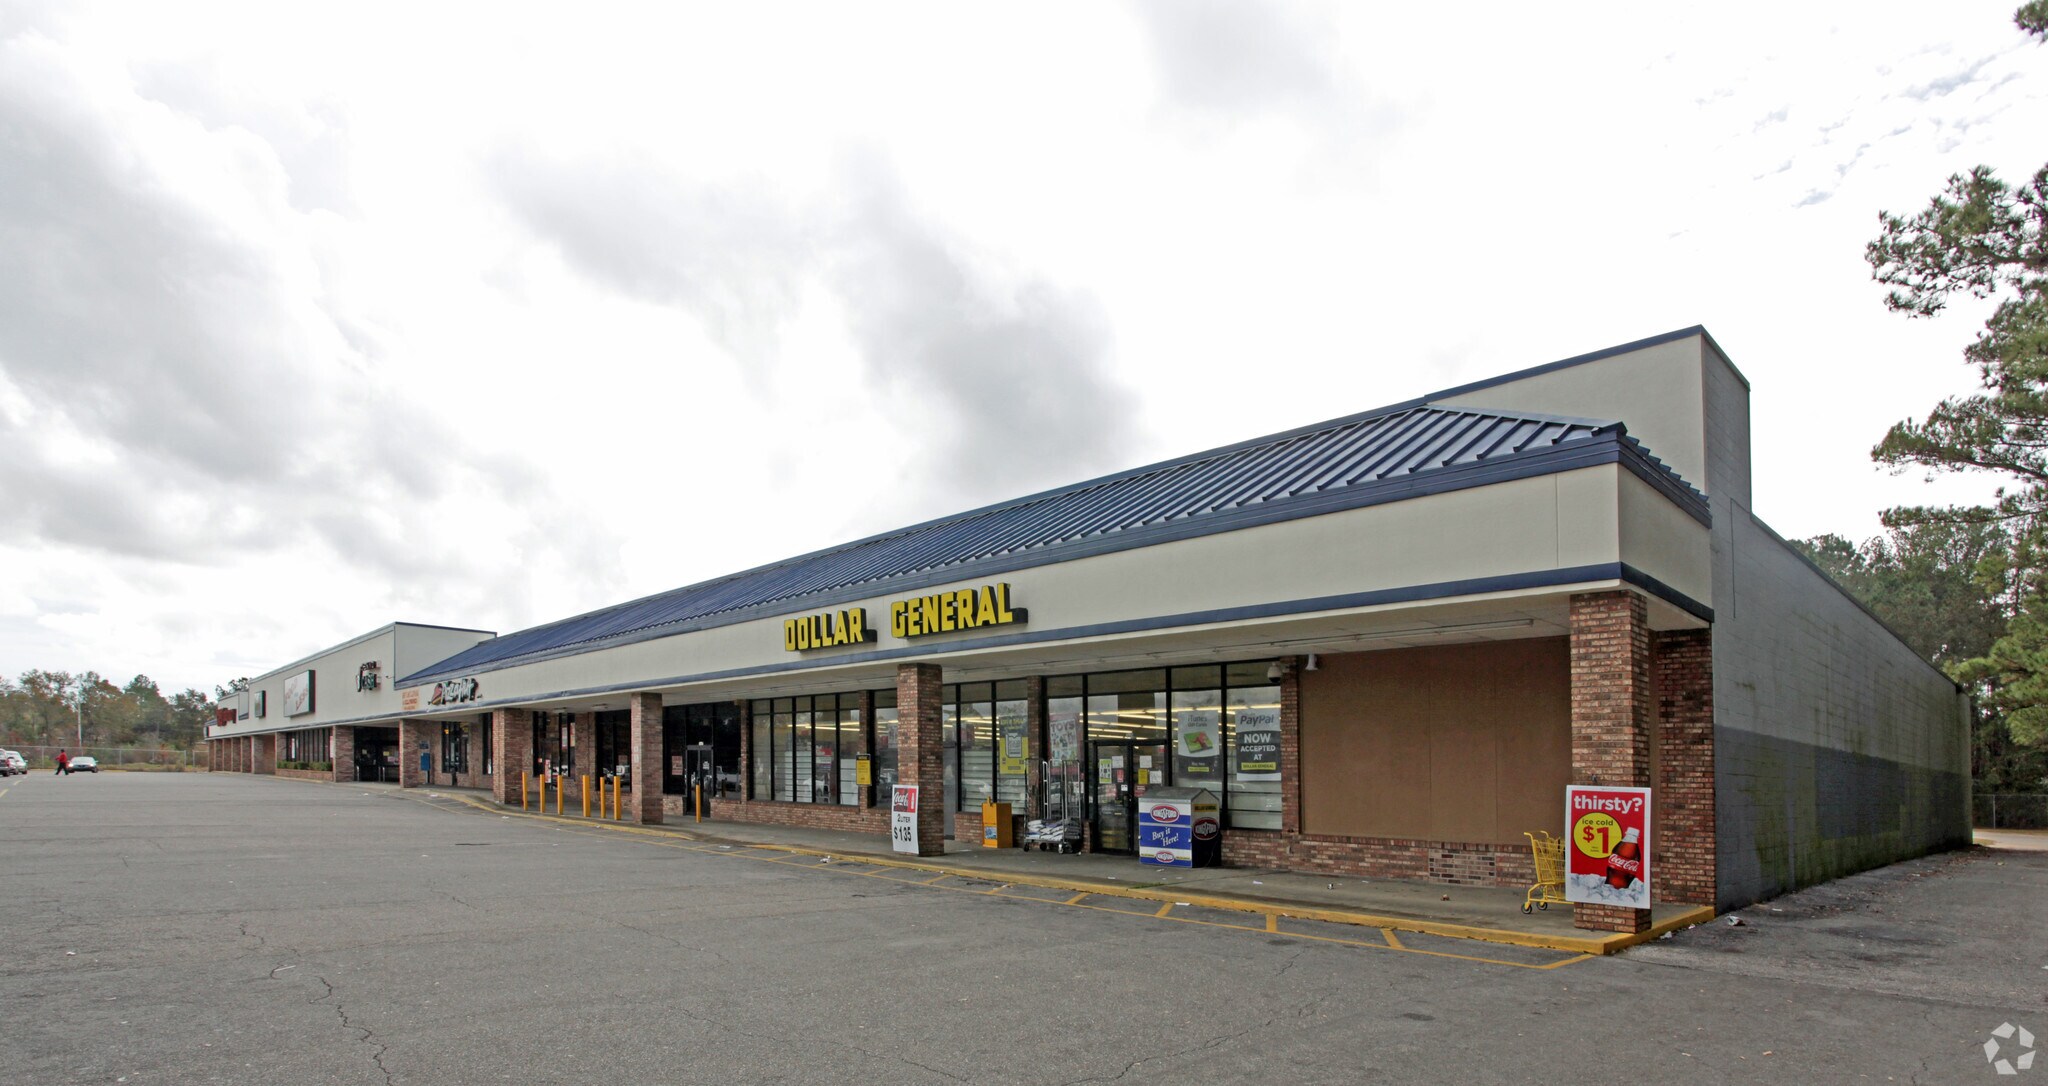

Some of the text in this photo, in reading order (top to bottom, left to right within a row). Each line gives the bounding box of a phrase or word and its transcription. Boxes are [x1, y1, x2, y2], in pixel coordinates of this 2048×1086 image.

[784, 583, 1014, 651] DOLLAR GENERAL
[1240, 714, 1274, 727] PayPal
[1243, 733, 1272, 744] NOW
[1574, 795, 1643, 814] thirsty?
[1152, 807, 1177, 820] KINGSFORD
[1152, 827, 1171, 841] Buy it
[1163, 833, 1179, 847] Here!
[1582, 825, 1609, 854] $1
